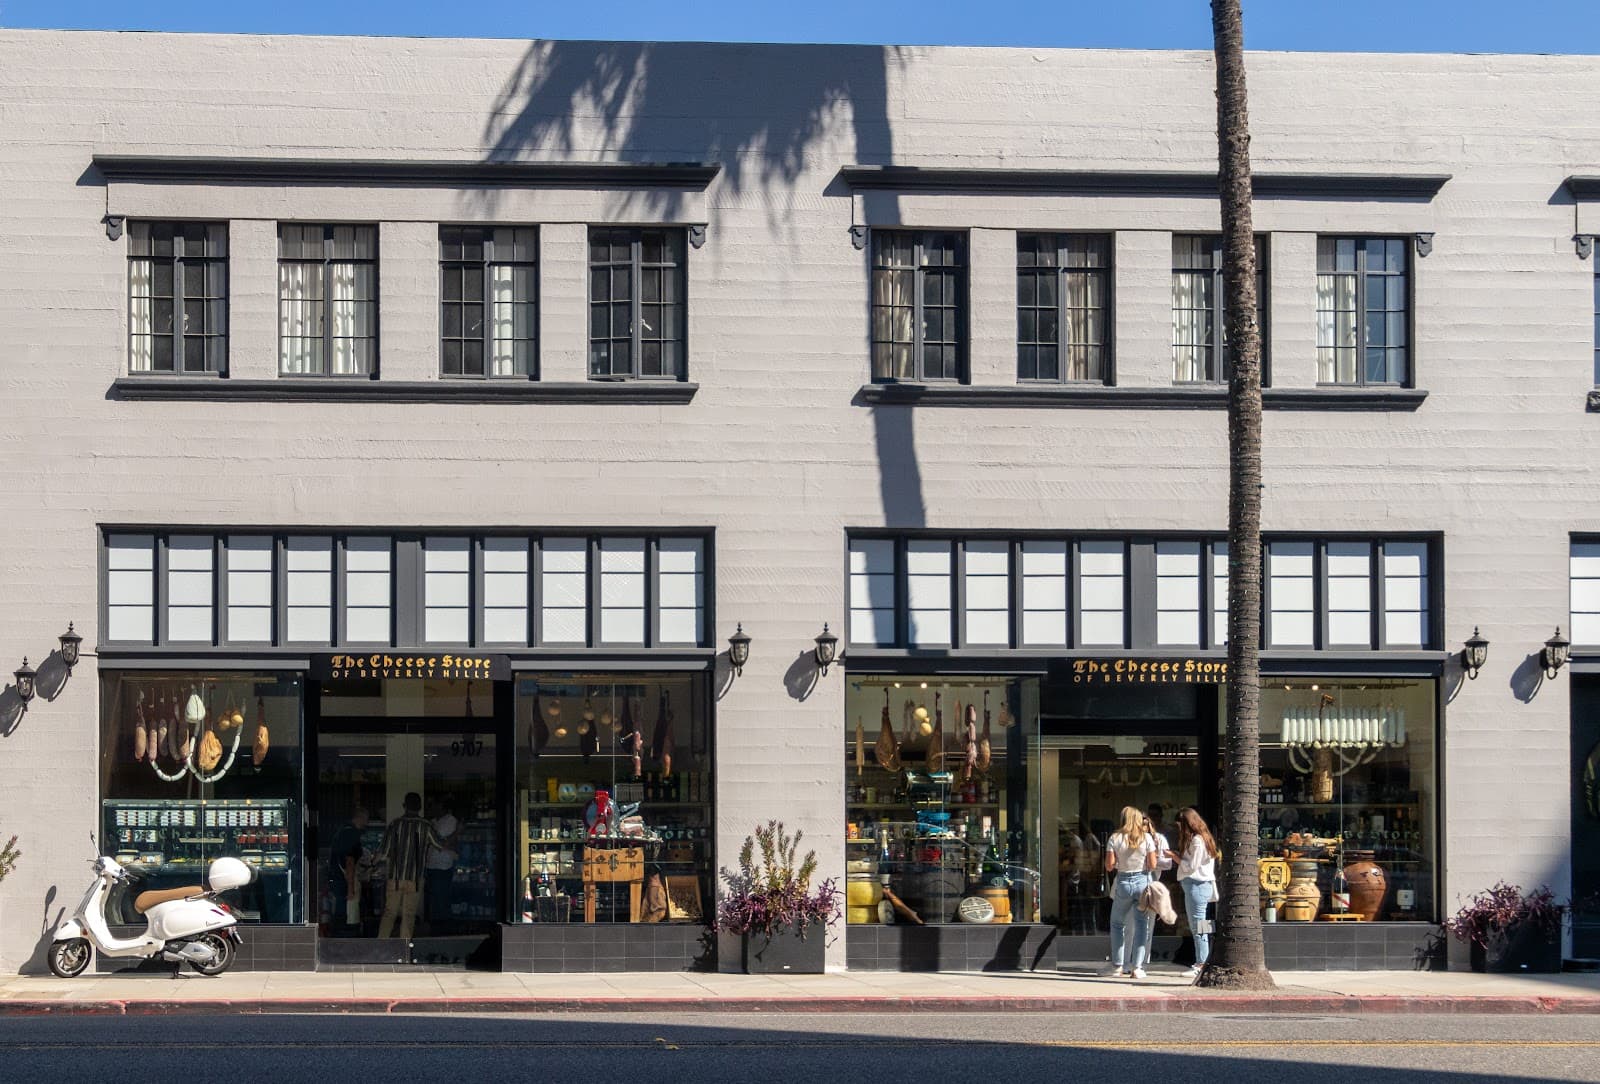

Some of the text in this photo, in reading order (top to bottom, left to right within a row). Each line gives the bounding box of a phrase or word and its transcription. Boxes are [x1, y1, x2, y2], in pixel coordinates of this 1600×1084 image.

[331, 654, 491, 669] The Cheese Store
[1073, 659, 1228, 673] The Cheese Store
[332, 669, 489, 679] OF BEVERLY HILLS
[1073, 674, 1227, 683] OF BEVERLY HILLS
[451, 741, 483, 757] 9707
[1153, 743, 1187, 758] 9705
